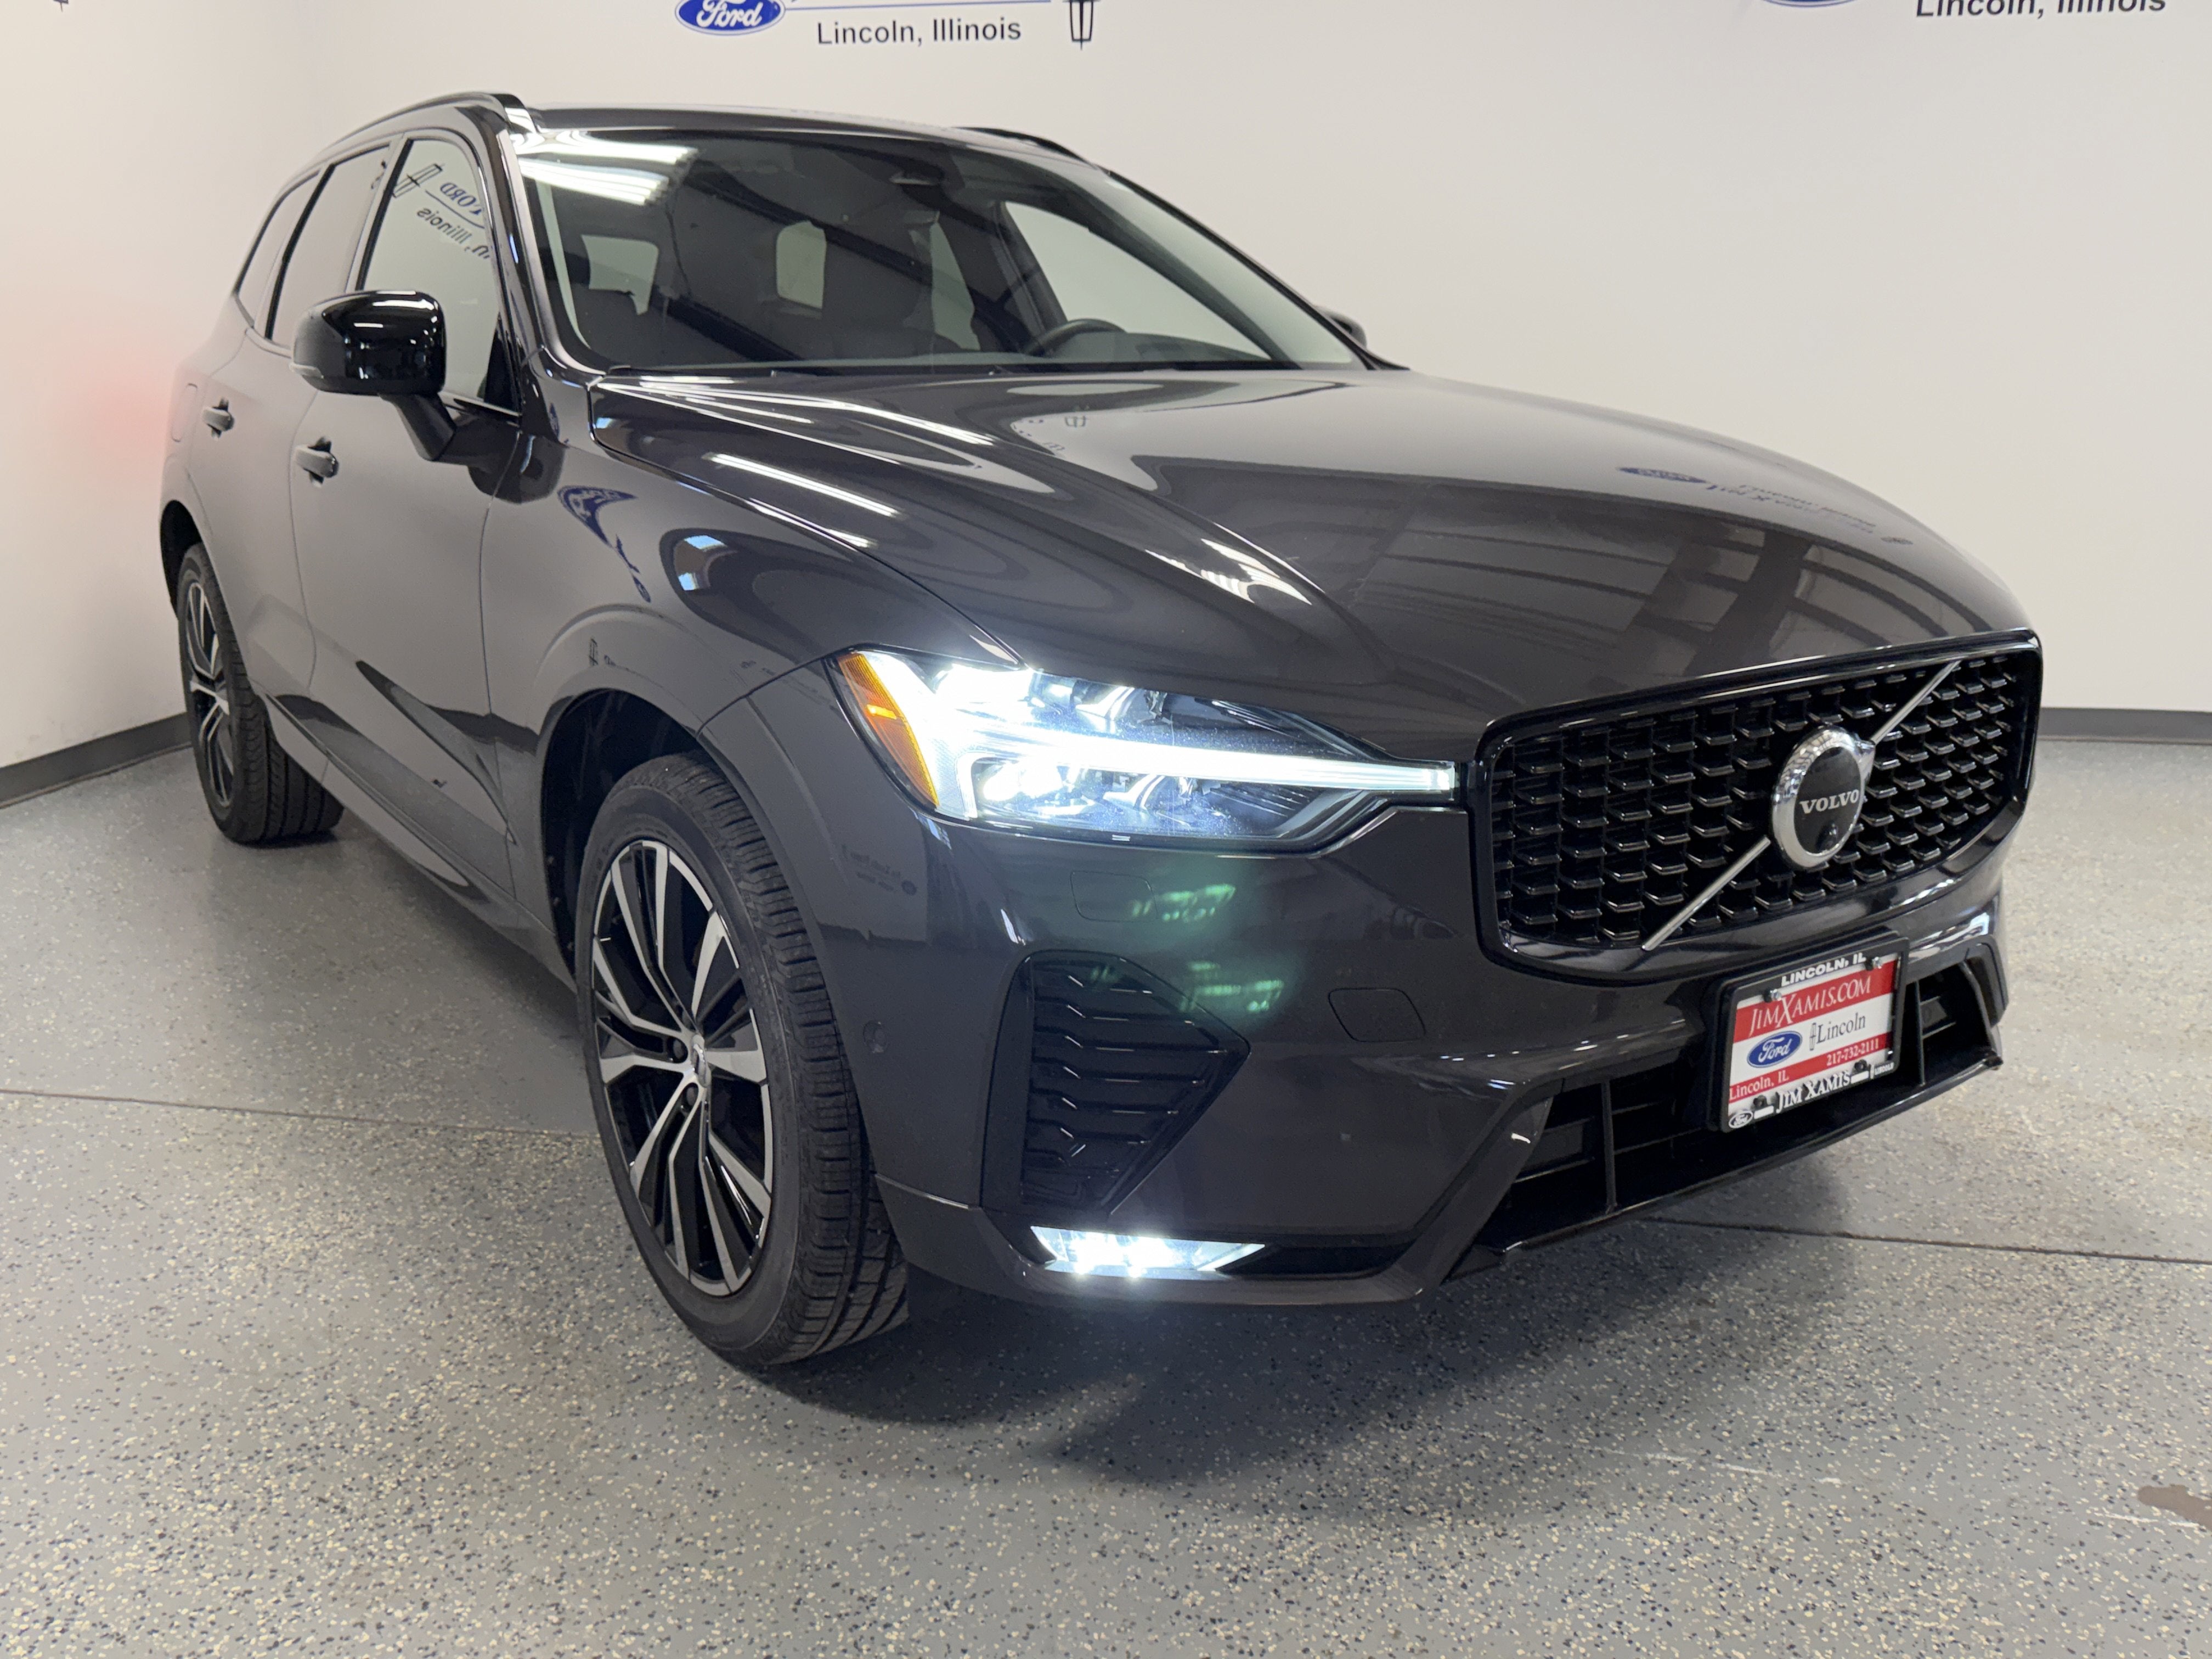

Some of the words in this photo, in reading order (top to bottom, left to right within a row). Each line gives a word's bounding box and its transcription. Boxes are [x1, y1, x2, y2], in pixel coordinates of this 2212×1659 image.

[696, 0, 763, 27] Ford
[817, 20, 922, 47] Lincoln,
[933, 16, 1022, 42] Illinois
[1799, 789, 1860, 815] VOLVO
[1852, 952, 1866, 964] IL
[1748, 975, 1871, 1038] JIMXAMIS.COM
[1816, 1012, 1866, 1044] Lincoln
[1758, 1036, 1793, 1063] Ford
[1826, 1037, 1879, 1066] 217-732-2111
[1778, 1070, 1790, 1084] IL
[1775, 1086, 1803, 1114] JIM
[1804, 1071, 1851, 1101] XAMIS
